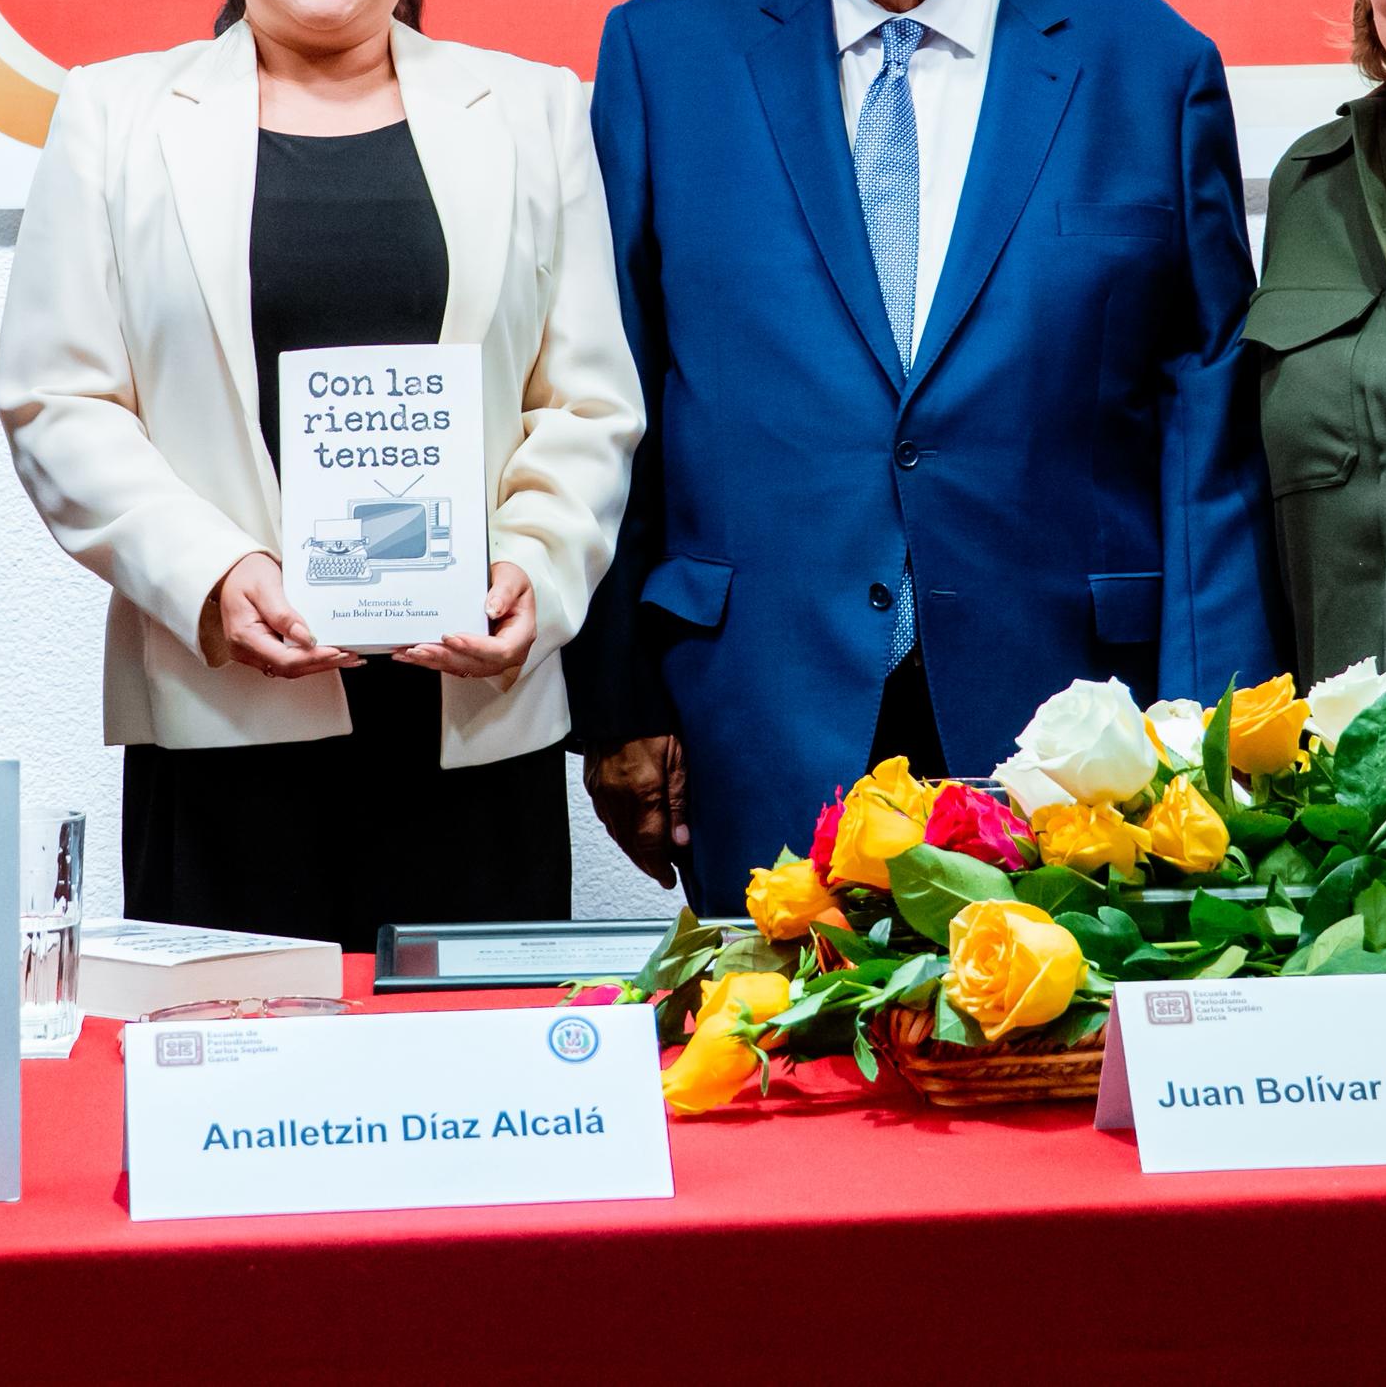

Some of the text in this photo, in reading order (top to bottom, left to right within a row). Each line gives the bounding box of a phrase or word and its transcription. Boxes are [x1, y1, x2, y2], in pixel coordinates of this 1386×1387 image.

[308, 368, 443, 398] Con las
[303, 403, 451, 434] riendas
[313, 441, 441, 469] tensas
[332, 609, 351, 620] Juan
[405, 608, 439, 617] Santana
[358, 597, 413, 607] Memorias de
[1158, 1080, 1245, 1109] Juan
[1256, 1074, 1382, 1105] Bolívar
[202, 1106, 605, 1151] Analletzin Díaz Alcalá
